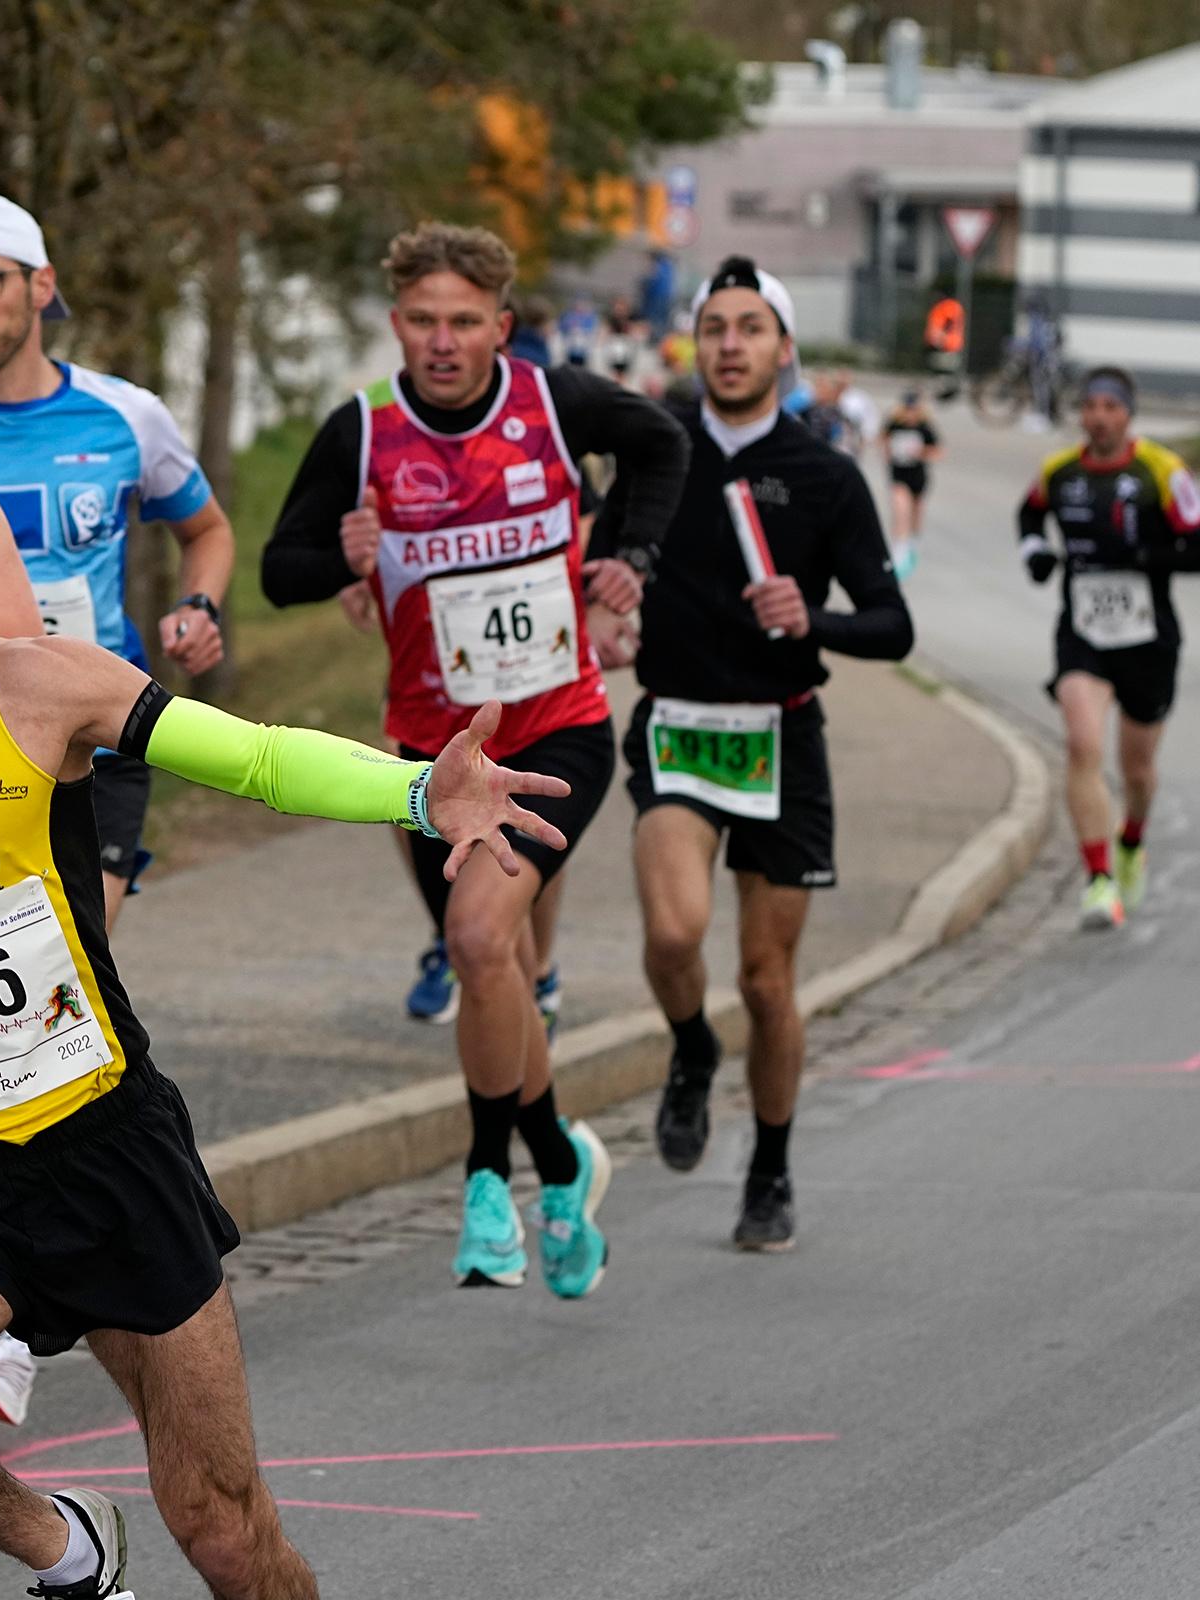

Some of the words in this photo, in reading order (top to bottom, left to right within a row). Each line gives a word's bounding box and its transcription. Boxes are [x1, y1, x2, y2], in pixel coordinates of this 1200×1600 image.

[403, 521, 547, 567] ARRIBA
[483, 602, 533, 647] 46
[679, 731, 749, 771] 913
[9, 904, 46, 923] Schmauser
[57, 1034, 93, 1061] 2022
[0, 1070, 37, 1092] Run
